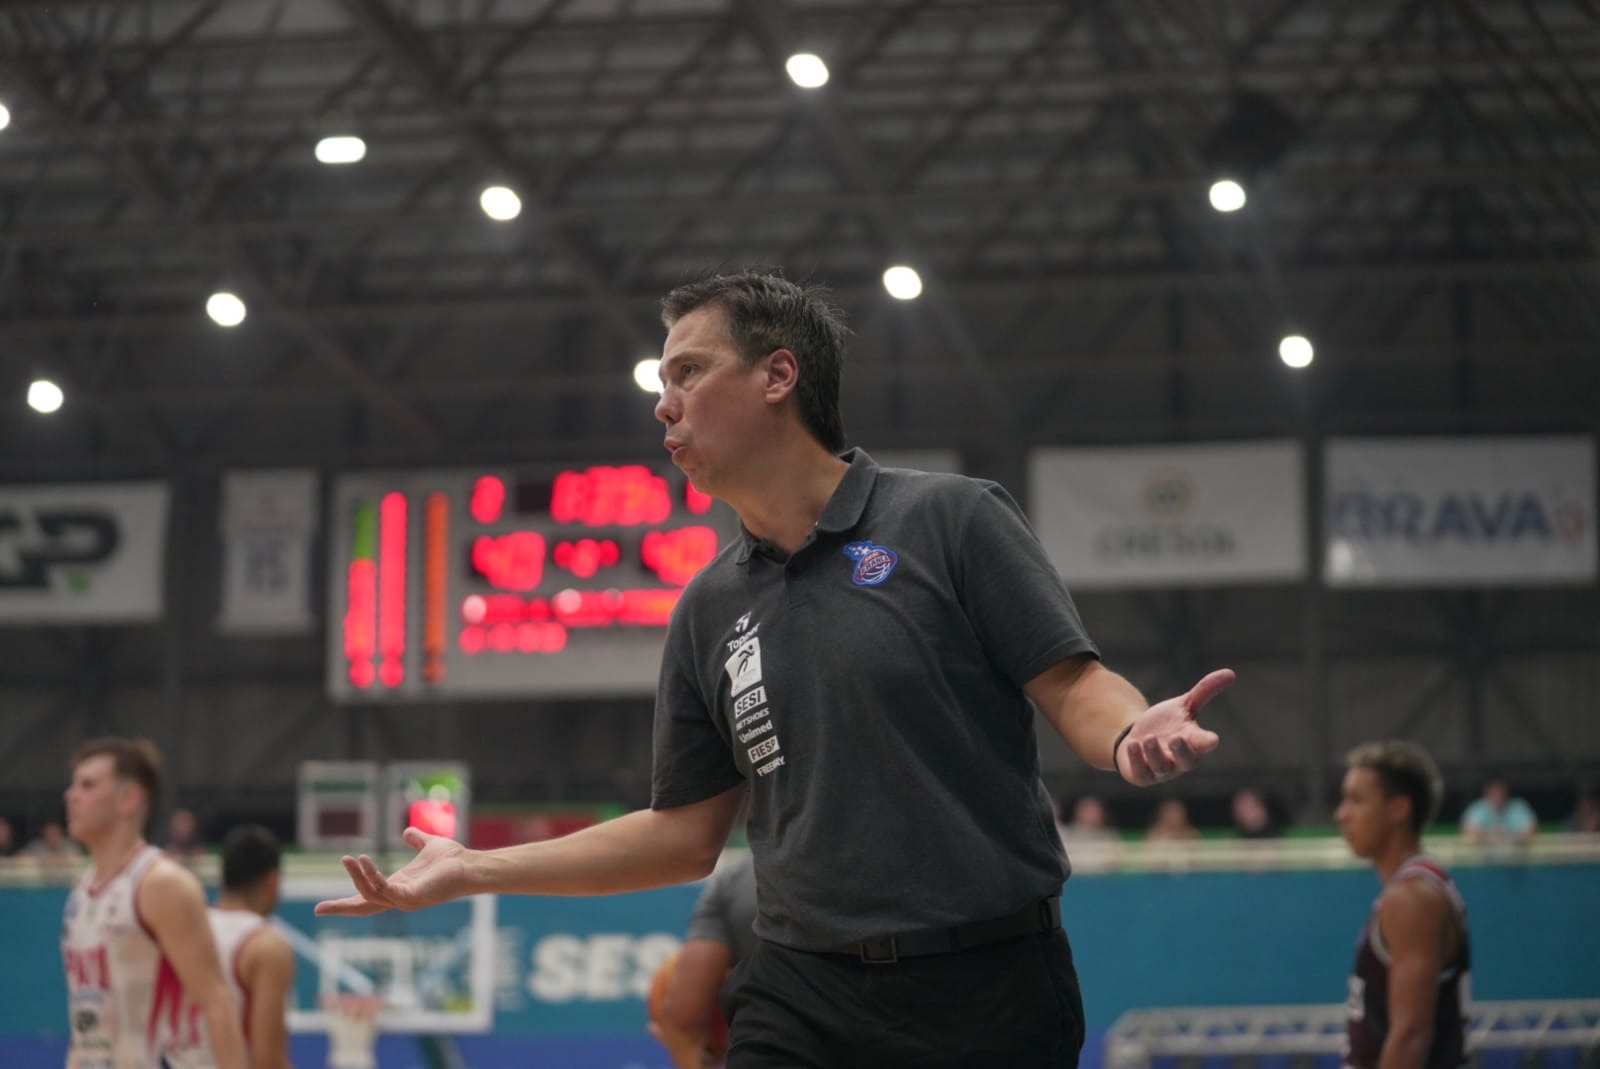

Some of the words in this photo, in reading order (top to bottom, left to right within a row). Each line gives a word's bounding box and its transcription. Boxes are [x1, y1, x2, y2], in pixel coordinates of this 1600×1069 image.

[736, 689, 762, 715] SESI
[739, 720, 773, 743] Unimed
[751, 738, 776, 762] FIESP
